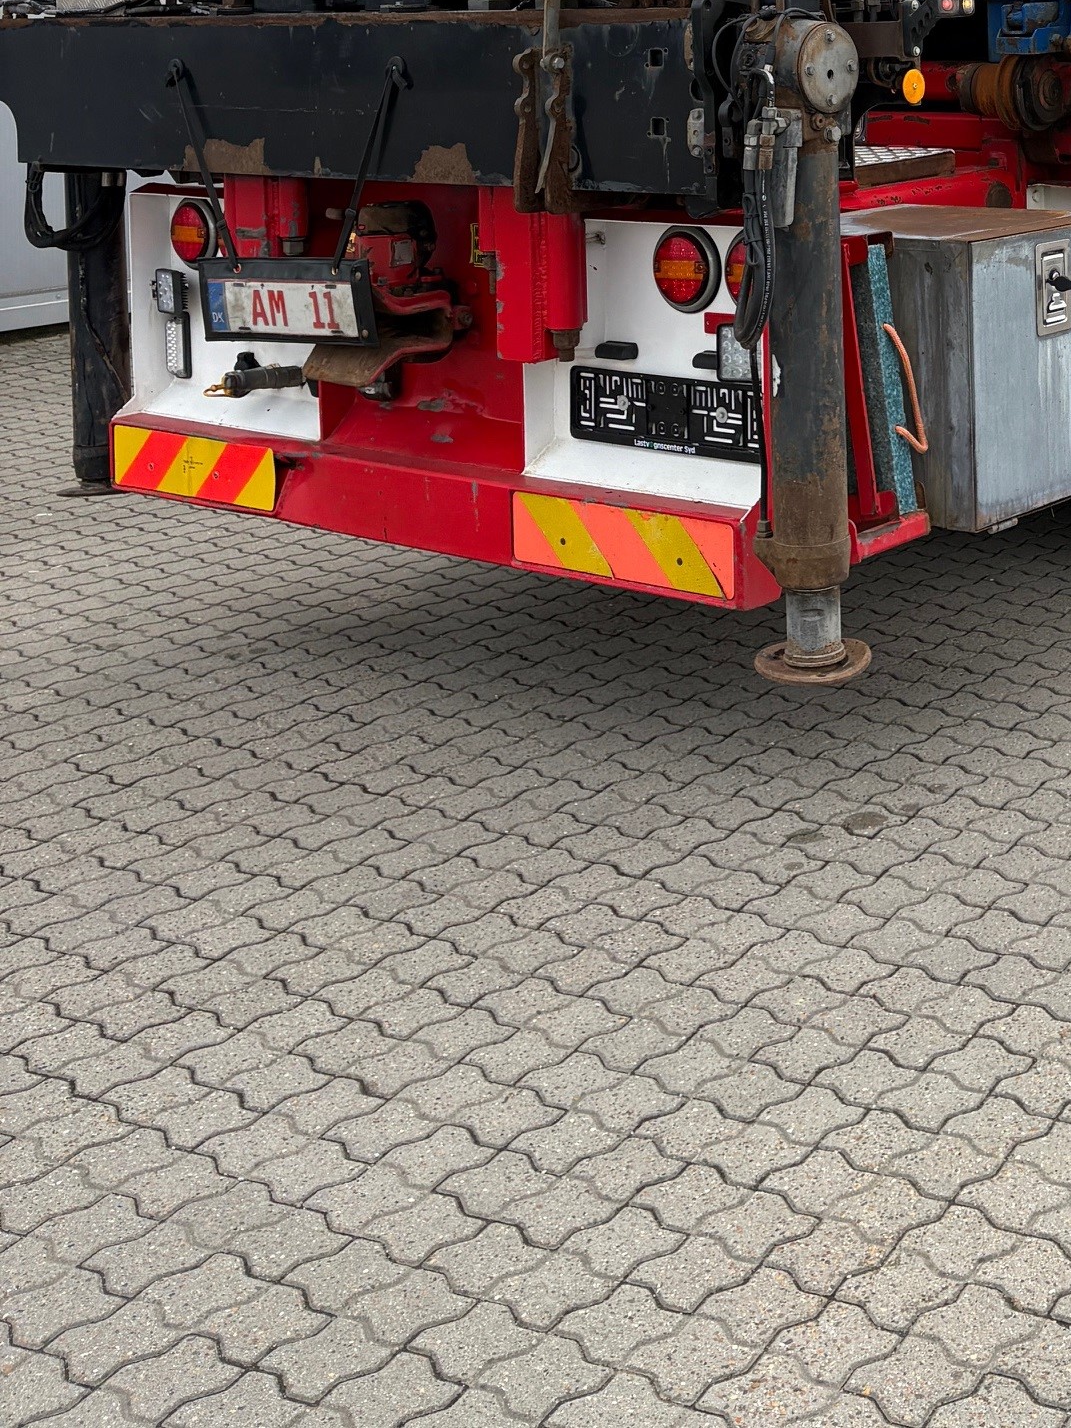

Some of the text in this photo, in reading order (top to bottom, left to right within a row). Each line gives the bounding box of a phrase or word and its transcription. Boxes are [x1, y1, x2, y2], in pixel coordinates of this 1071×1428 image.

[252, 289, 340, 330] AM 11
[212, 311, 225, 323] DK
[684, 445, 696, 454] Syd
